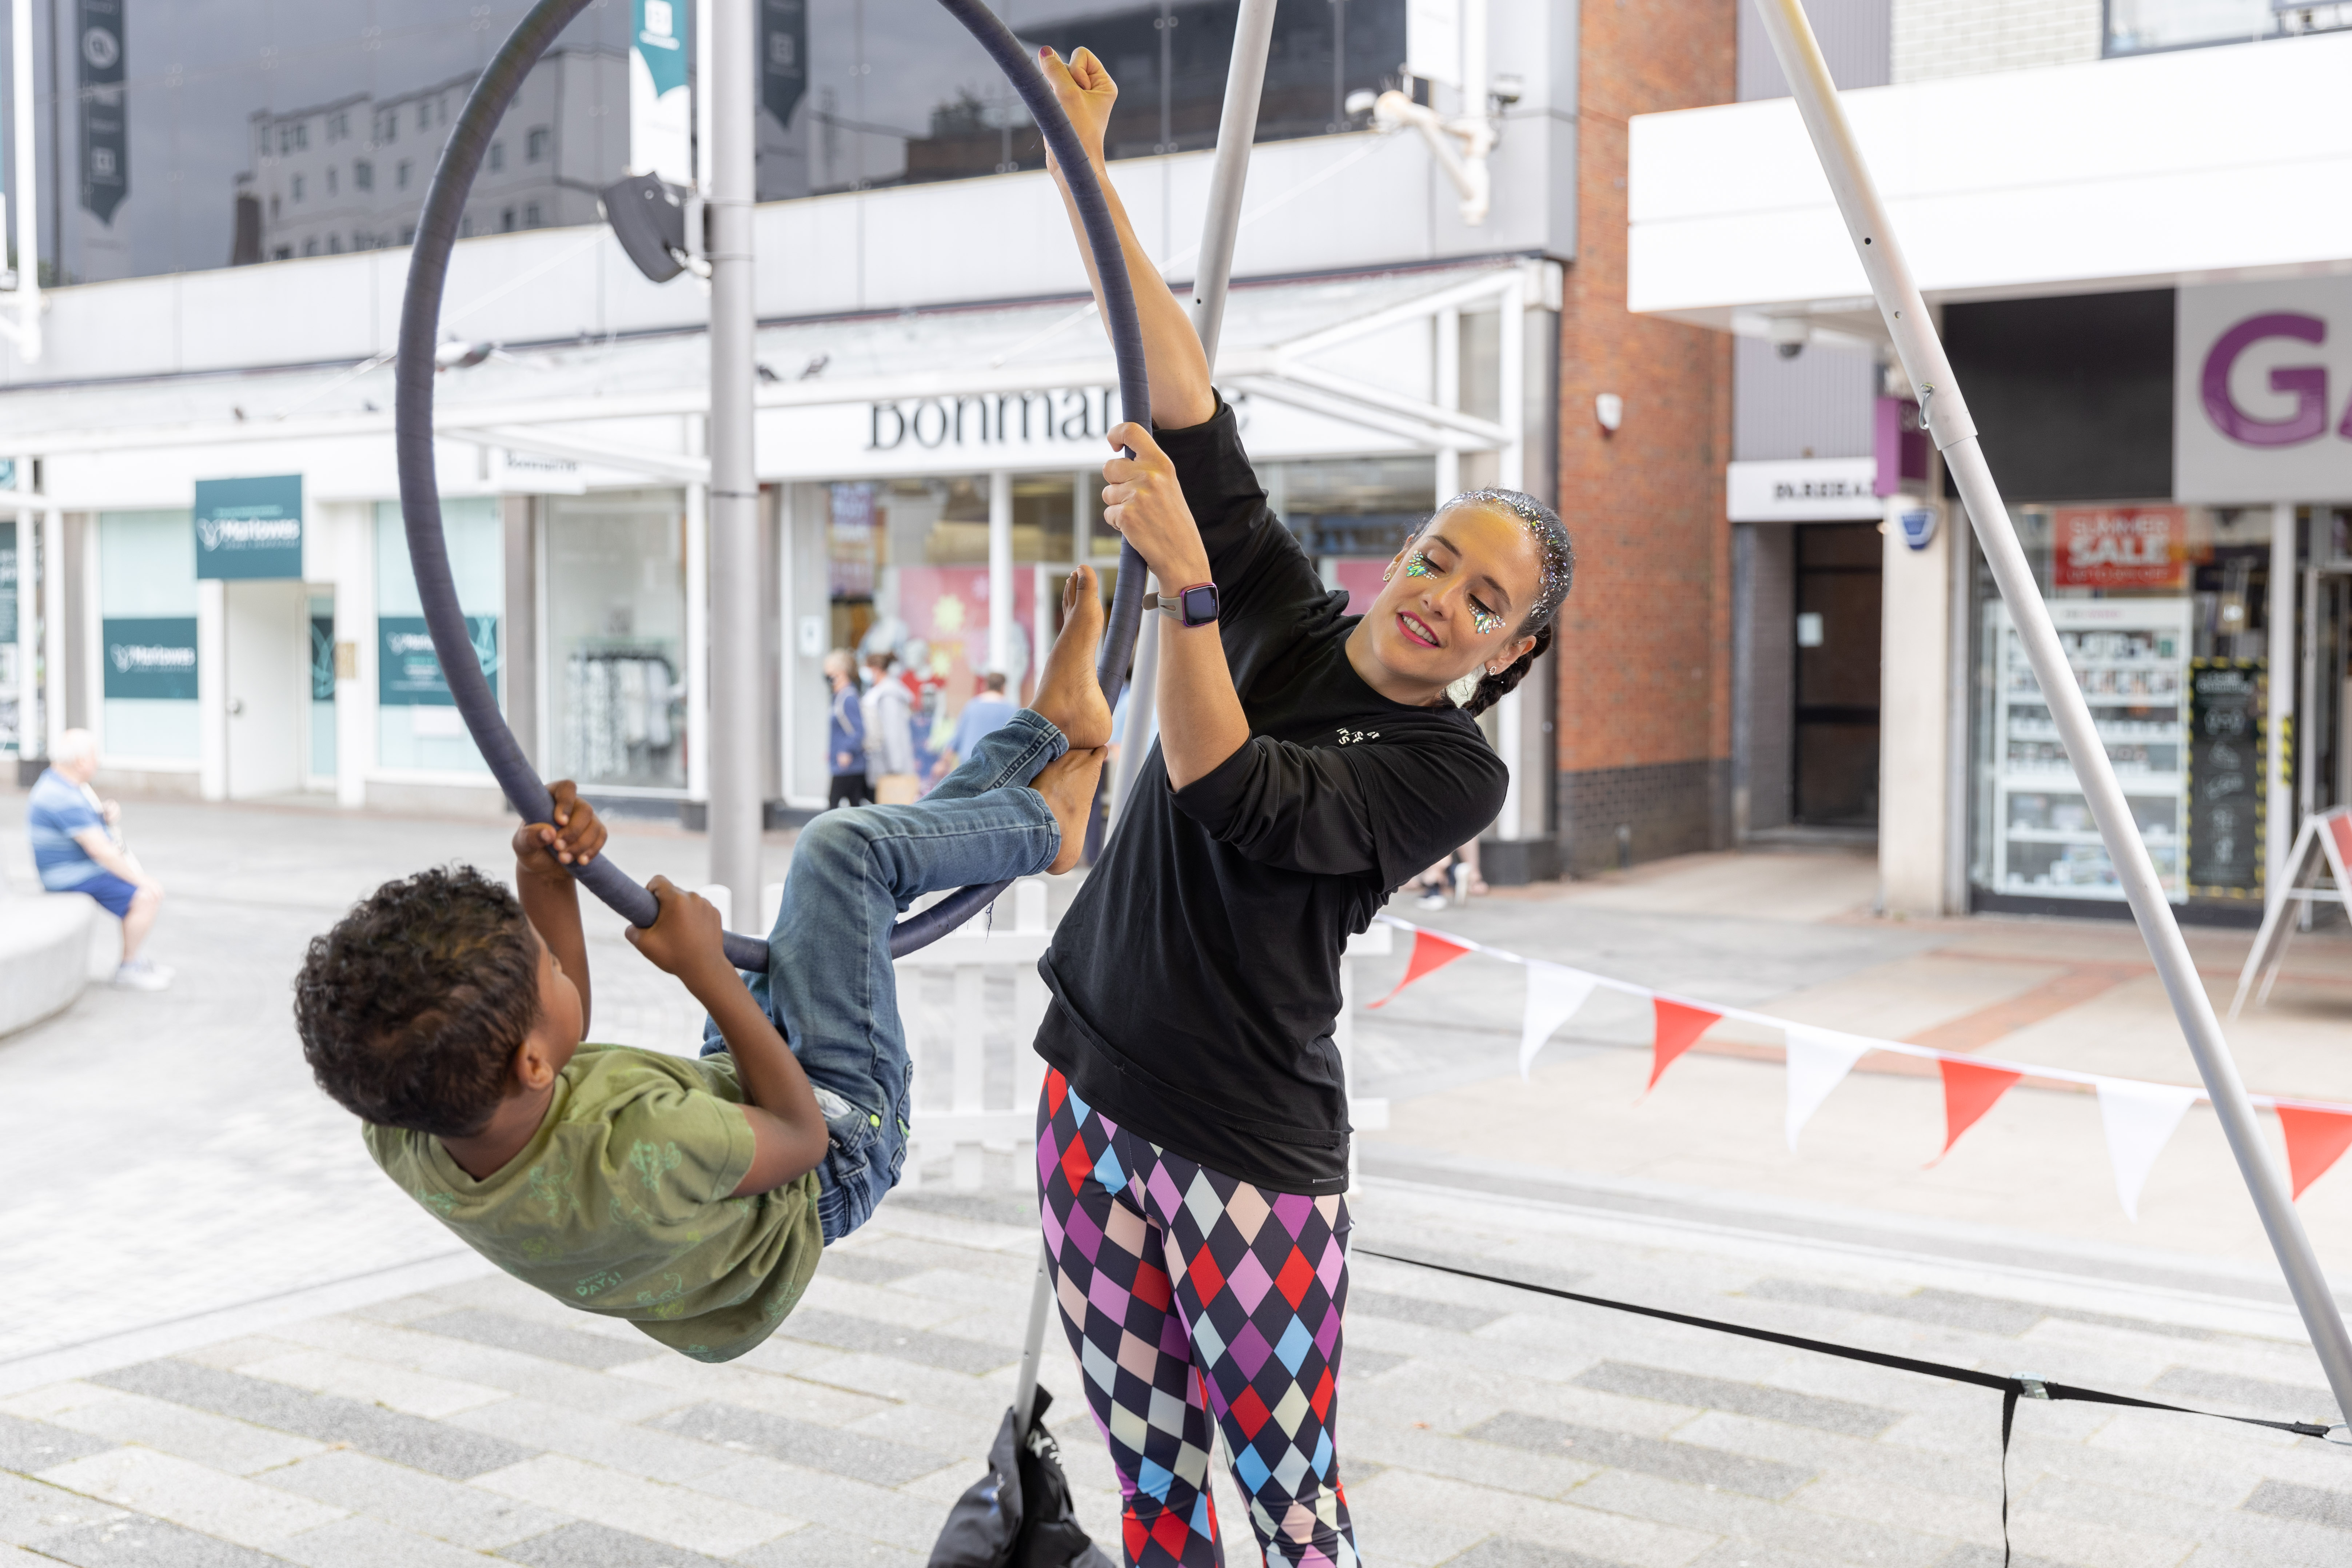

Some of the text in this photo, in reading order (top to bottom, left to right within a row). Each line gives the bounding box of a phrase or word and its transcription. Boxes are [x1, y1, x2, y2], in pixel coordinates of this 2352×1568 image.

[2198, 309, 2352, 450] G
[2068, 535, 2170, 567] SALE
[575, 1271, 623, 1297] DAYS!
